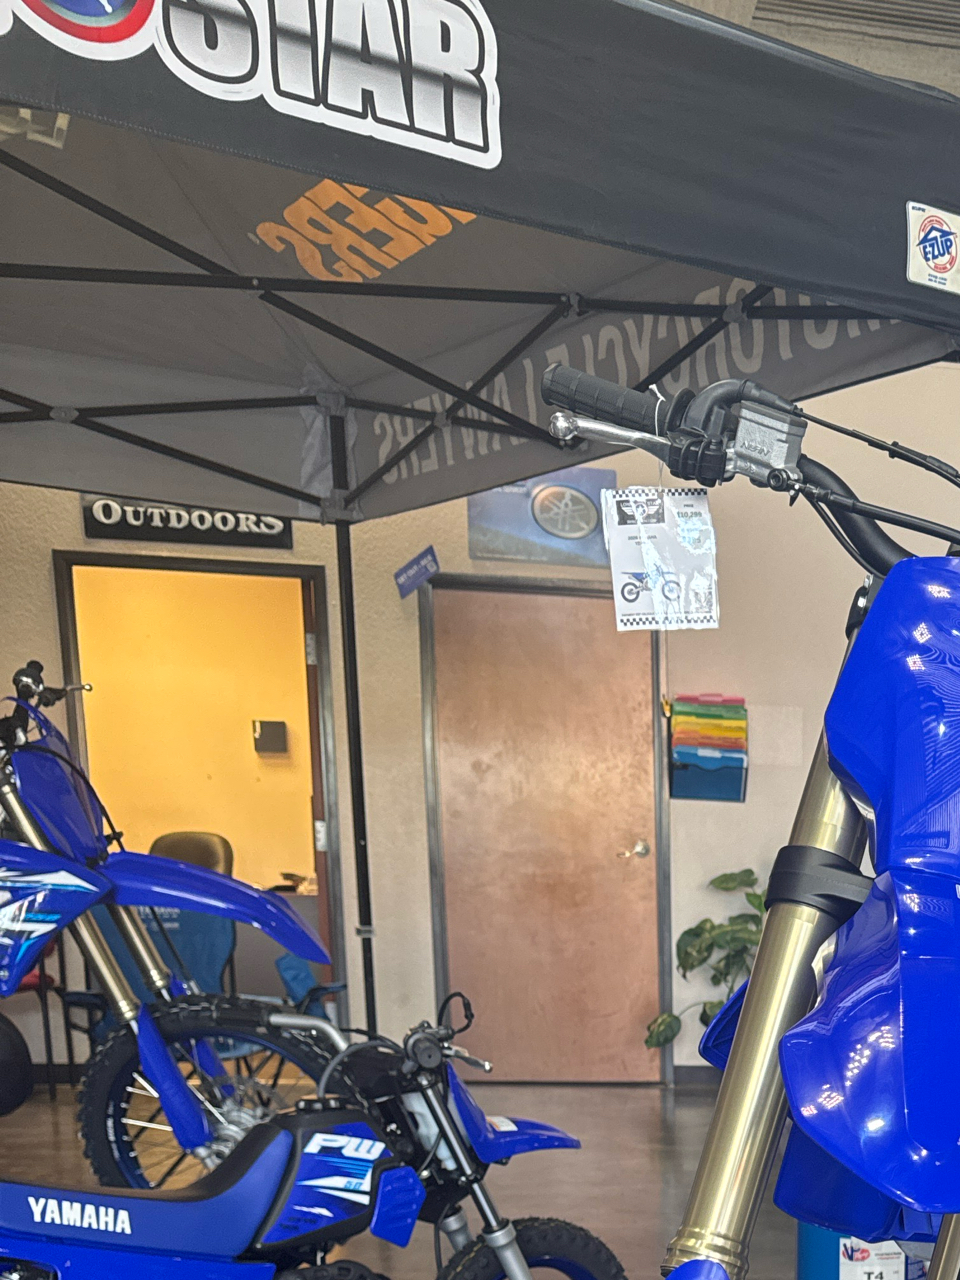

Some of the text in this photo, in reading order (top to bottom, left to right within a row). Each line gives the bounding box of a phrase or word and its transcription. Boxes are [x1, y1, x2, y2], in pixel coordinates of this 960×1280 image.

[92, 500, 284, 535] OUTDOORS
[304, 1132, 386, 1160] PW
[27, 1196, 132, 1235] YAMAHA
